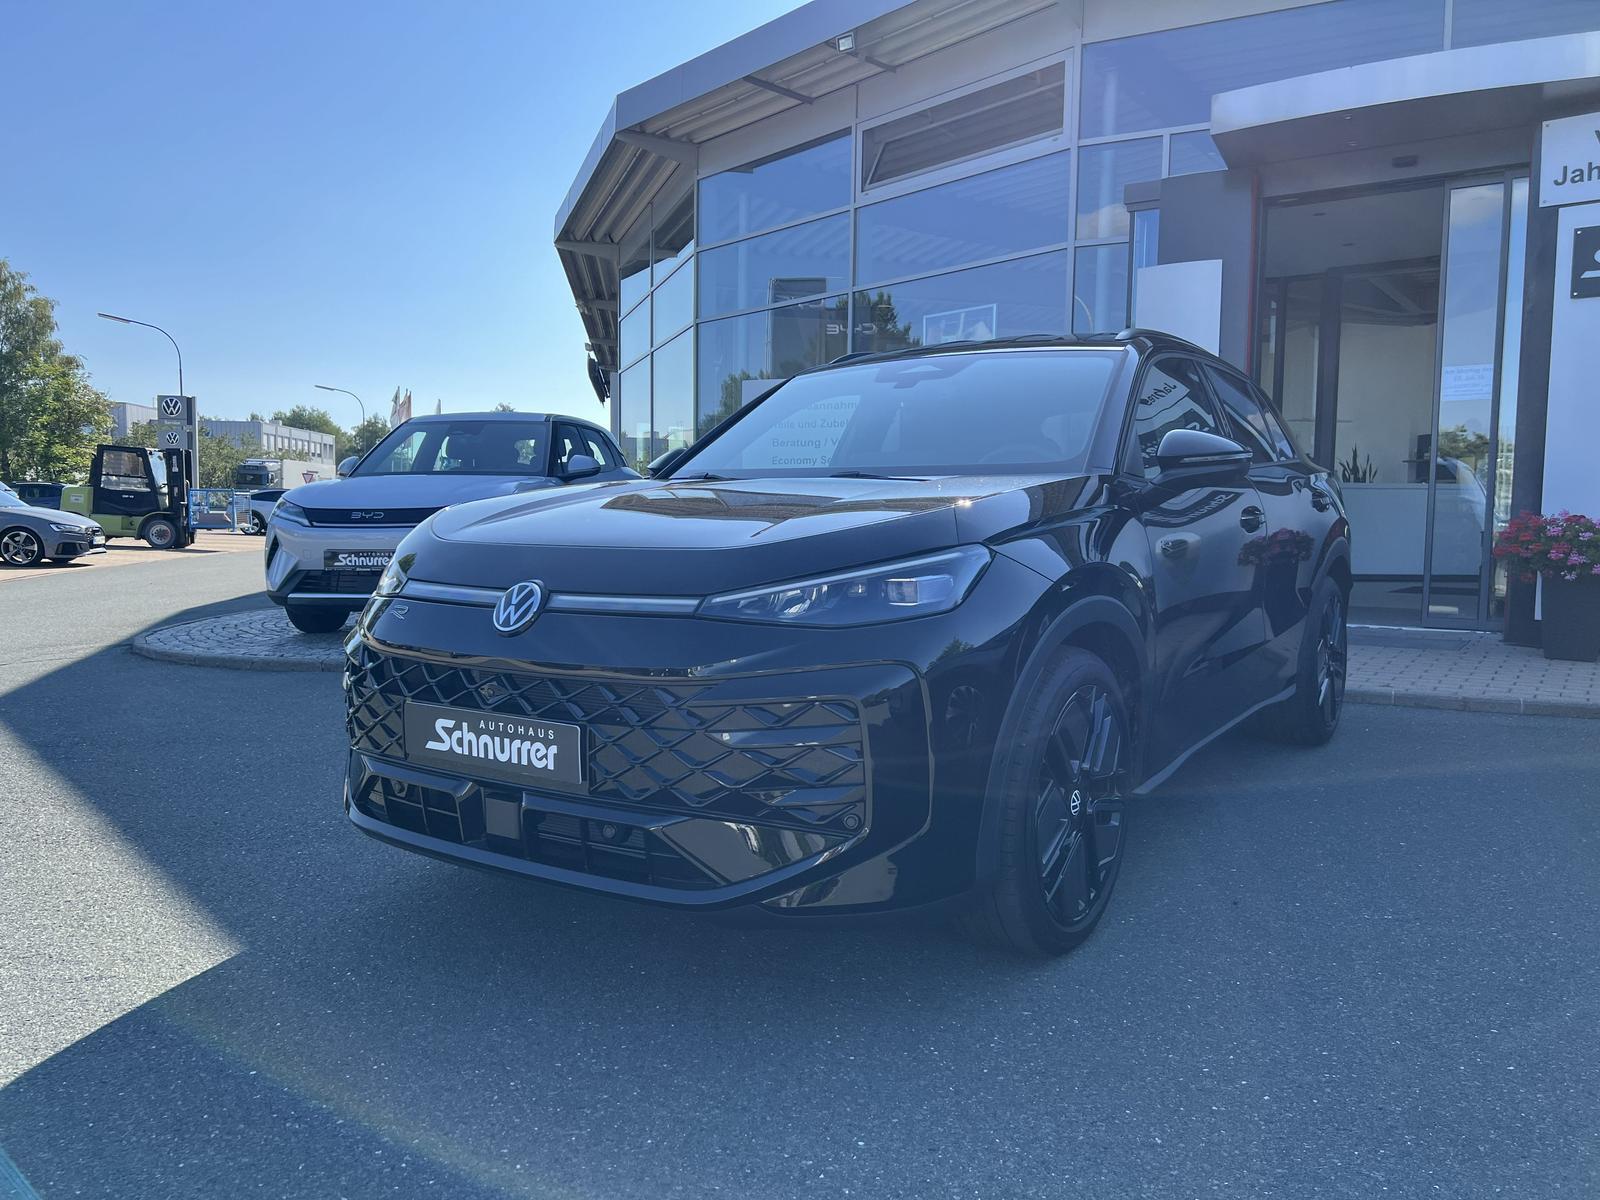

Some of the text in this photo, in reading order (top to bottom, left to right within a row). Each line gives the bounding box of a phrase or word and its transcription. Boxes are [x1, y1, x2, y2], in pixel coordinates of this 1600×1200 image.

[772, 438, 821, 449] Beratung
[771, 456, 818, 467] Economy
[351, 511, 385, 519] BYD
[334, 553, 390, 566] Schnurre
[479, 719, 555, 739] AUTOHAUS
[425, 718, 558, 770] Schnurrer
